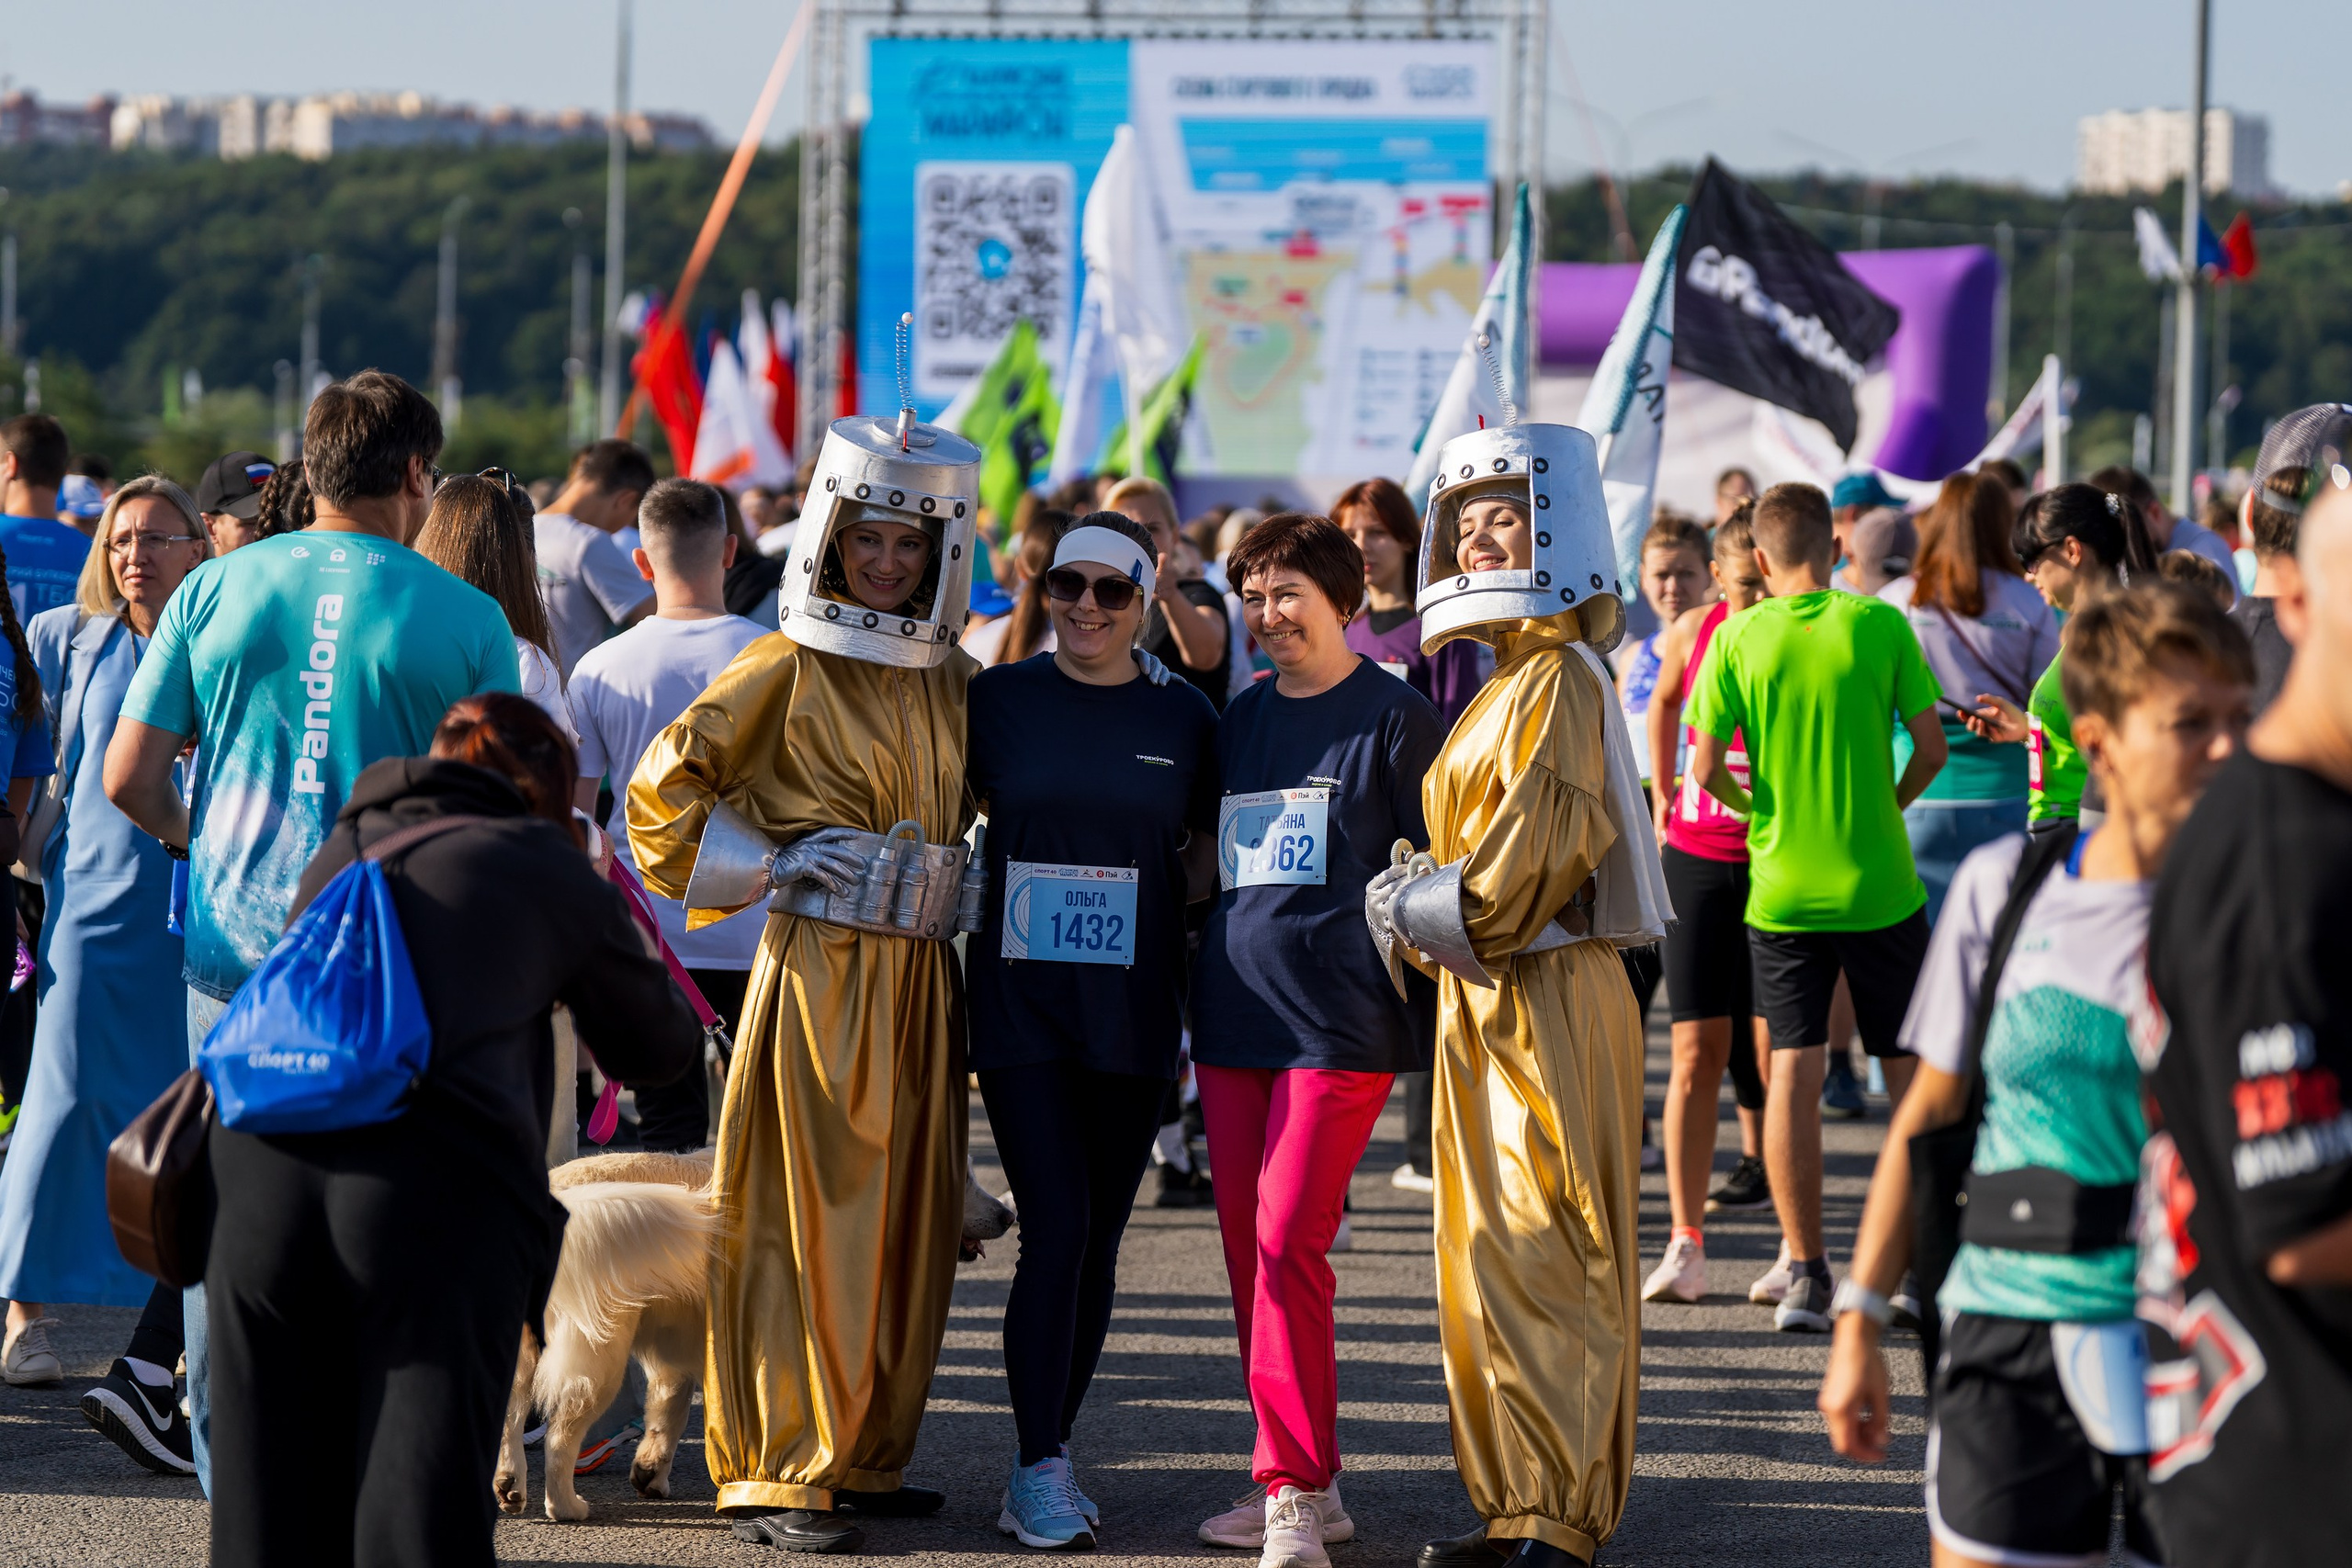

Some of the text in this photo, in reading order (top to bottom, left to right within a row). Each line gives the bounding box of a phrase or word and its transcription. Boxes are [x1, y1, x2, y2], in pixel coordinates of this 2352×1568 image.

[293, 594, 344, 794] Pandora
[1248, 835, 1315, 873] 2362
[1066, 891, 1107, 908] ОЛЬГА
[1051, 912, 1124, 952] 1432
